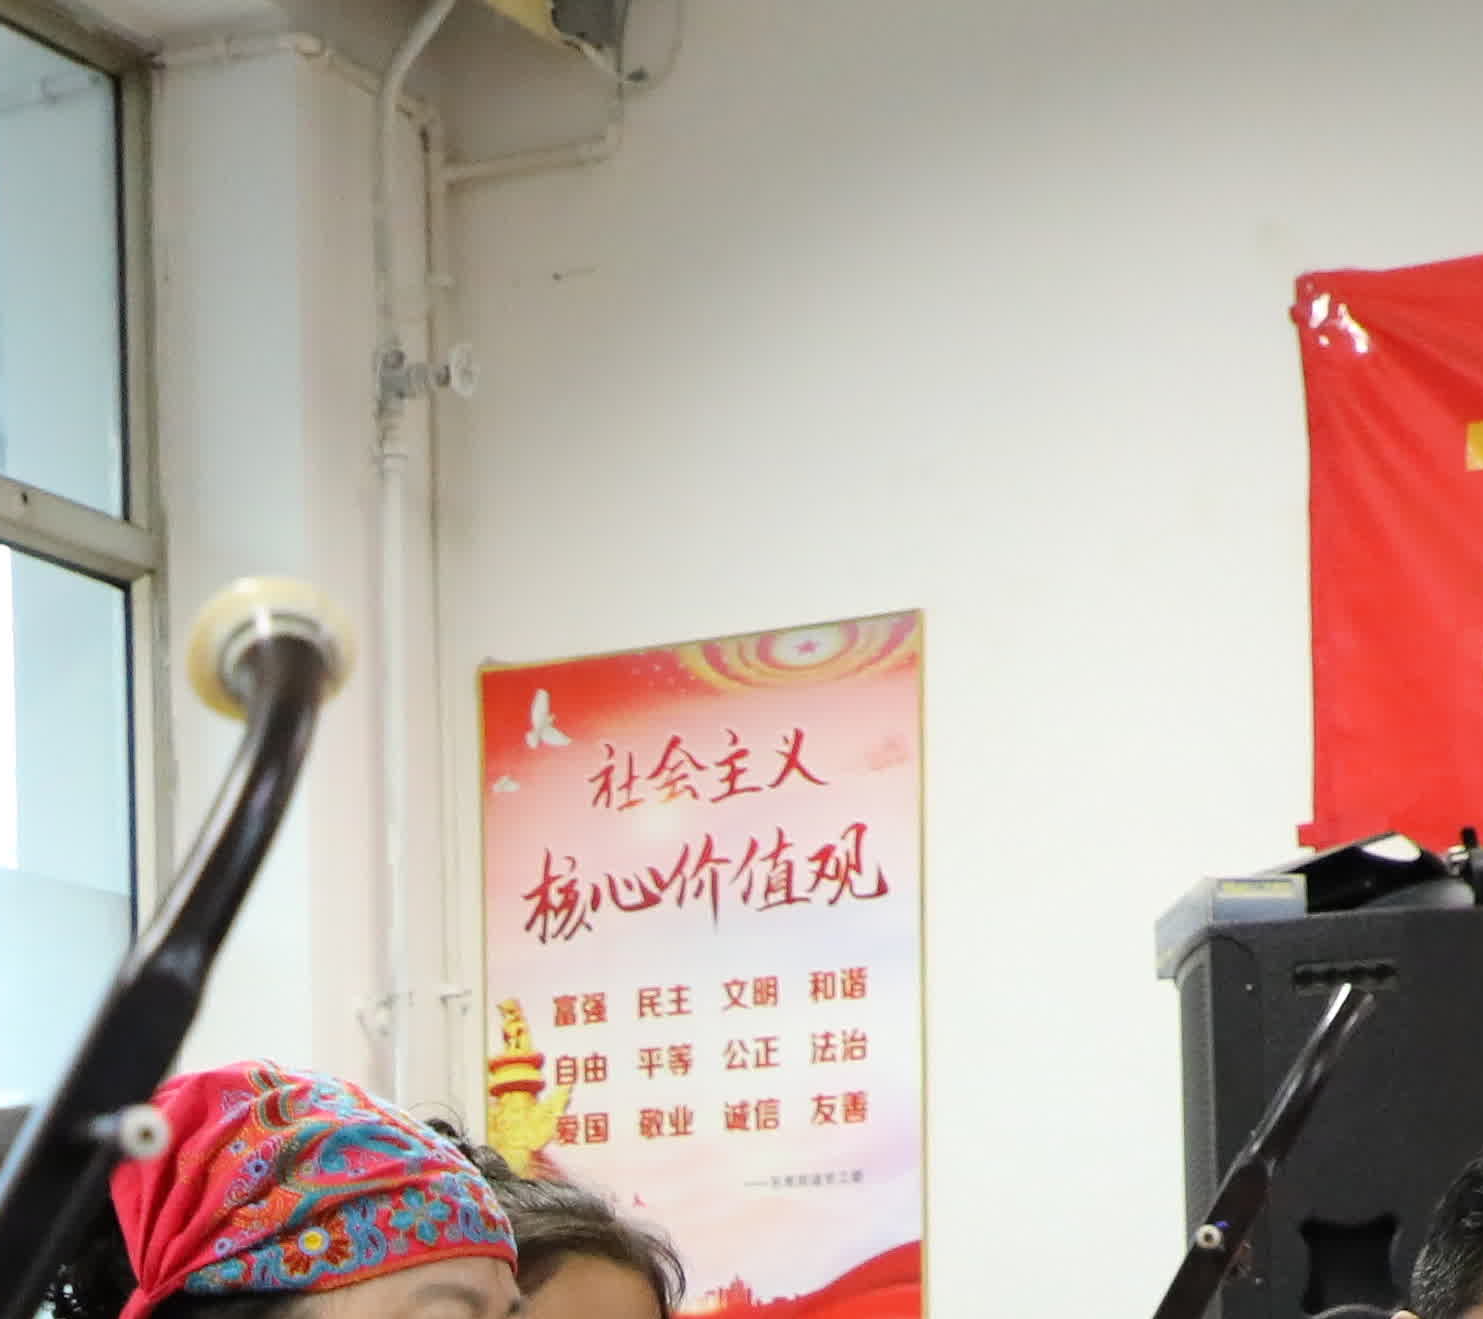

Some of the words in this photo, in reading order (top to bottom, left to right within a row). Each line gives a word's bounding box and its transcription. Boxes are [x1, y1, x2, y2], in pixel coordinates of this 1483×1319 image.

[589, 728, 830, 811] 社会主义
[522, 821, 889, 944] 核心价值观
[552, 993, 609, 1027] 富强
[637, 985, 692, 1019] 民主
[722, 977, 780, 1010] 文明
[809, 967, 869, 1003] 和谐
[554, 1051, 609, 1086] 自由
[638, 1043, 694, 1078] 平等
[723, 1036, 781, 1071] 公正
[810, 1029, 869, 1064] 法治
[555, 1111, 610, 1146] 爱国
[639, 1105, 695, 1140] 敬业
[723, 1099, 782, 1133] 诚信
[810, 1091, 869, 1127] 友善
